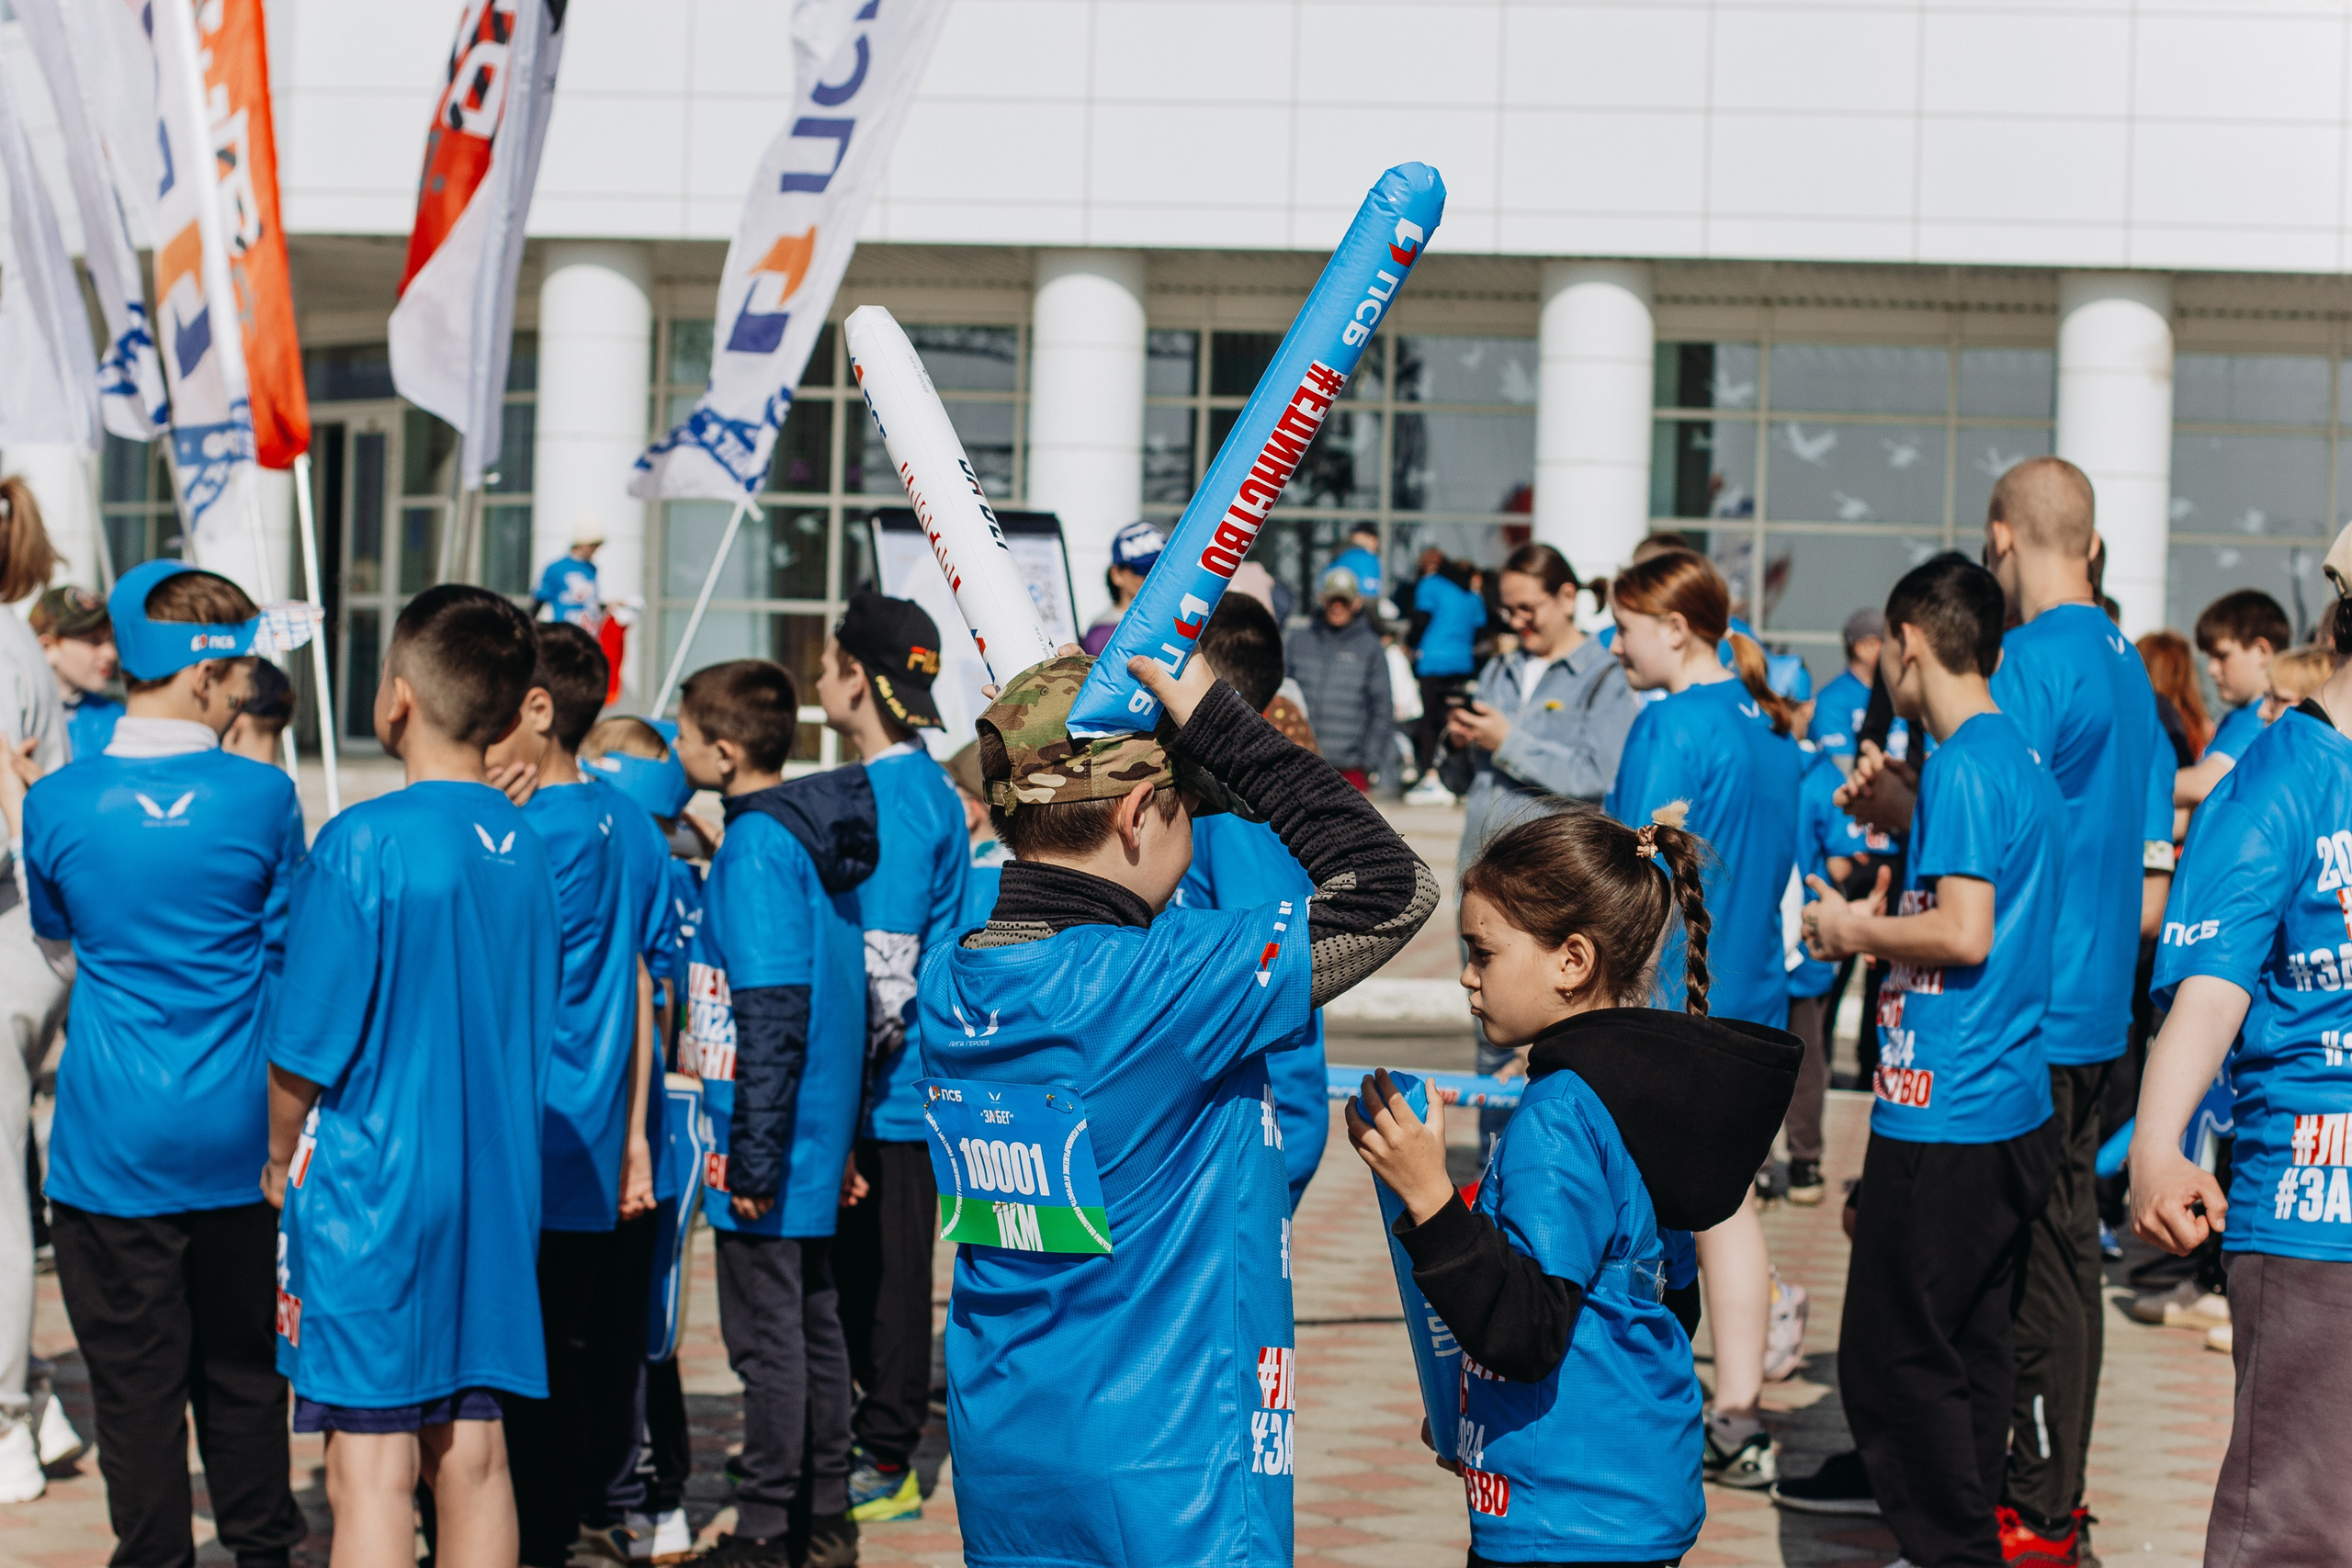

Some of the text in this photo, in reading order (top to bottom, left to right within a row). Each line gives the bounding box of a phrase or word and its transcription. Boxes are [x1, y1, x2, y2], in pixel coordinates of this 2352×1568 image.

[1342, 269, 1399, 348] ПСБ
[1202, 363, 1346, 579] #ЕДИНСТВО
[1128, 642, 1186, 716] ПБ
[2163, 919, 2220, 947] ПСБ
[966, 1039, 990, 1047] ГЕРОЕВ
[941, 1089, 962, 1102] ПСБ
[959, 1137, 1050, 1196] 10001
